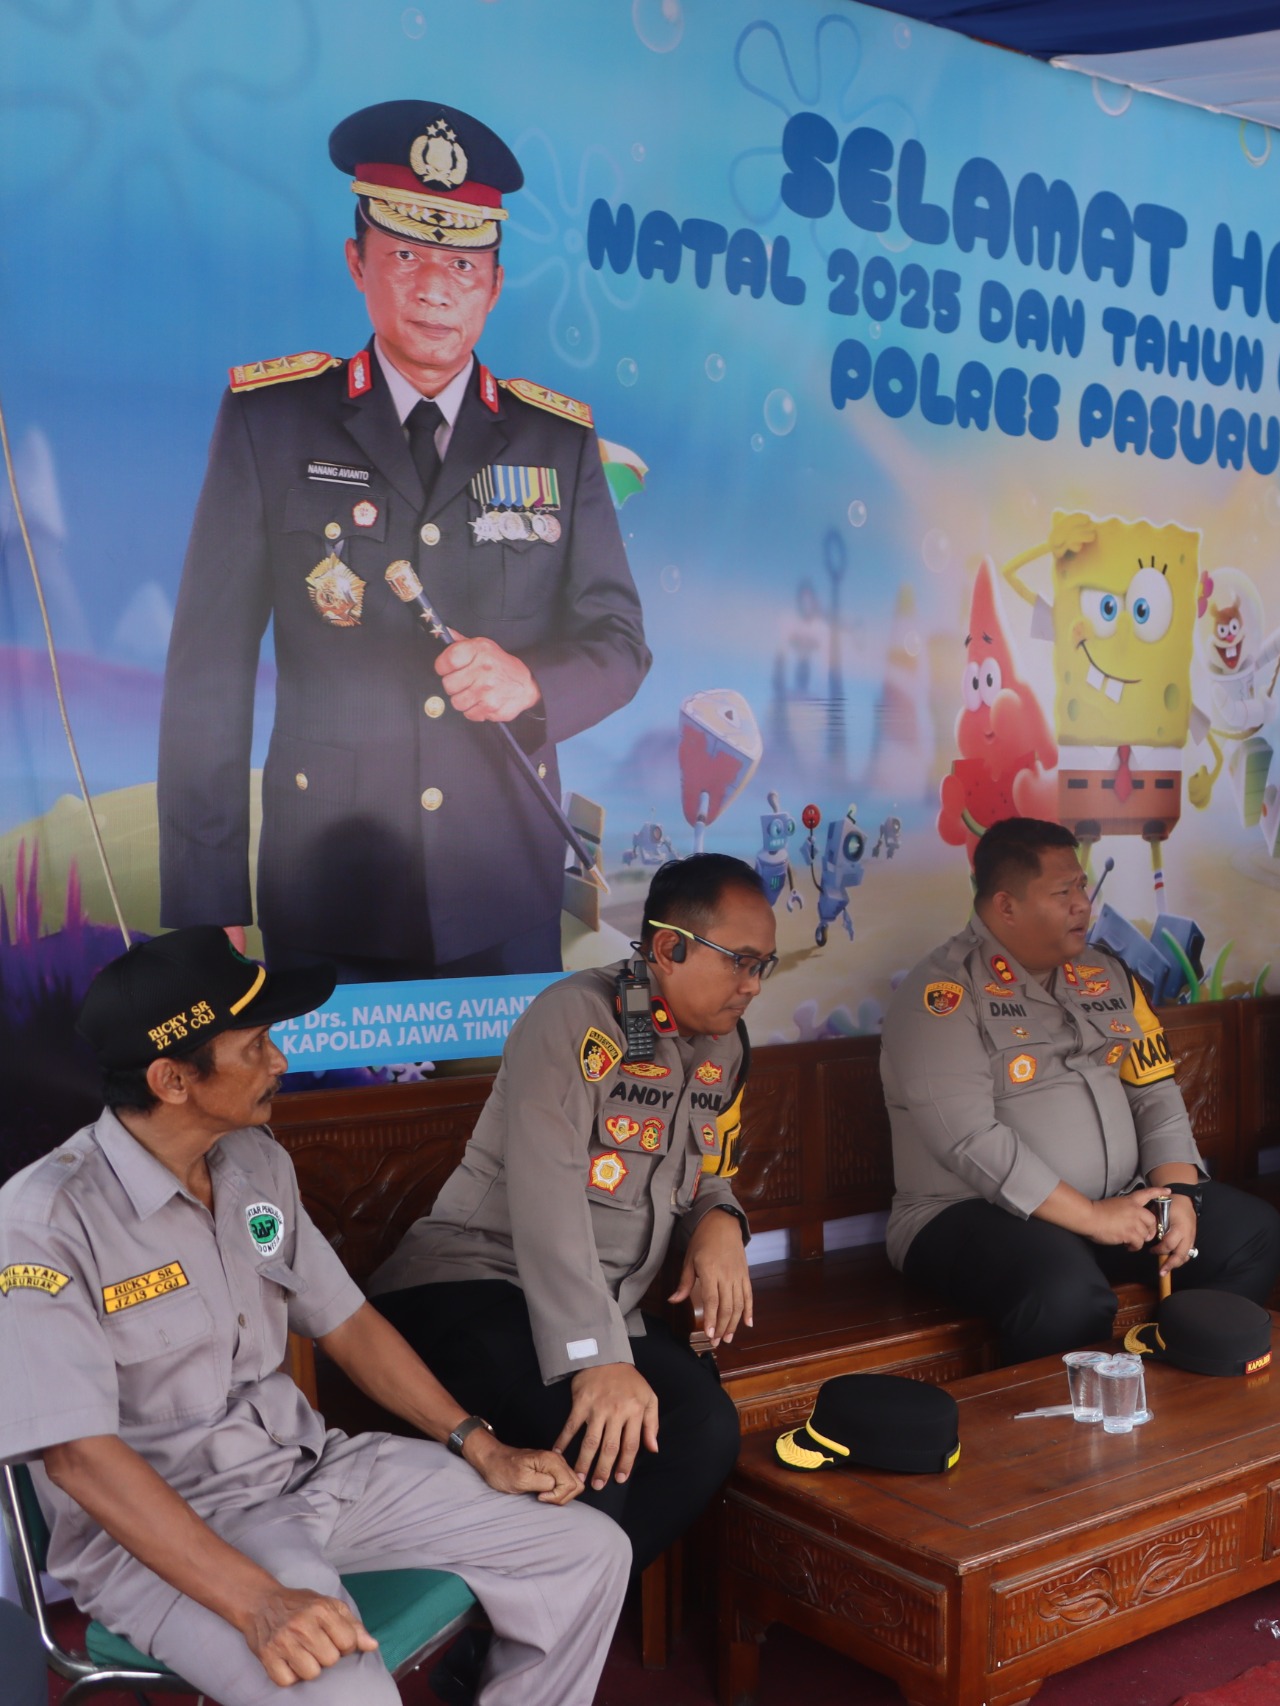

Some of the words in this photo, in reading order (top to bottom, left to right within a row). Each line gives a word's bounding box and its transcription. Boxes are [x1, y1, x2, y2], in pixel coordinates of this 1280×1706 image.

[780, 111, 1188, 297] SELAMAT
[587, 197, 805, 306] NATAL
[827, 248, 962, 334] 2025
[979, 280, 1085, 359] DAN
[1102, 307, 1263, 393] TAHUN
[829, 338, 1061, 442] POLRES
[308, 464, 338, 477] NANANG
[338, 469, 369, 481] AVIANTO
[304, 1010, 347, 1030] Drs.
[352, 1001, 453, 1026] NANANG
[990, 1002, 1027, 1018] DANI
[1081, 998, 1127, 1014] POLRI
[148, 1012, 188, 1041] RICKY
[191, 1001, 210, 1017] SR
[156, 1035, 172, 1050] JZ
[173, 1025, 188, 1040] 13
[190, 1009, 215, 1029] CQJ
[283, 1028, 393, 1055] KAPOLDA
[397, 1023, 459, 1046] JAWA
[609, 1081, 673, 1109] ANDY
[114, 1275, 151, 1296] RICKY
[157, 1267, 174, 1280] SR
[115, 1297, 132, 1309] JZ
